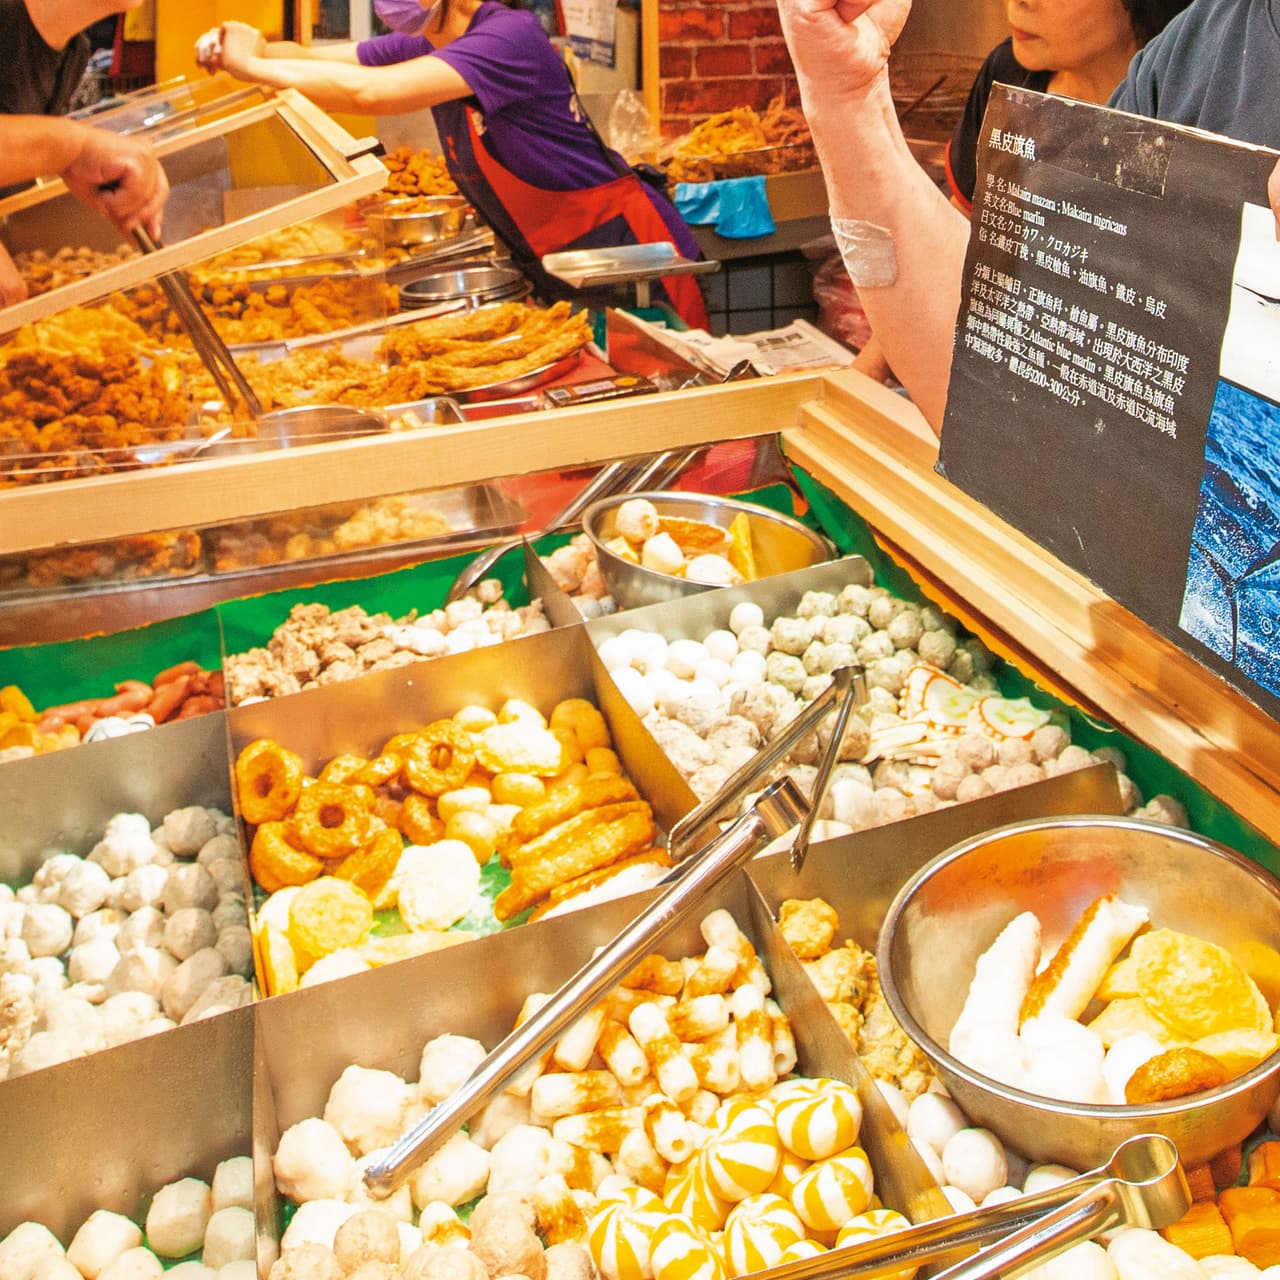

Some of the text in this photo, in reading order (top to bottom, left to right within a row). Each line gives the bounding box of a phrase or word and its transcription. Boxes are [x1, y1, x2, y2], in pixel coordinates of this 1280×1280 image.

[988, 127, 1036, 161] 黑皮旗魚
[1007, 181, 1031, 202] Makaira
[1031, 193, 1056, 212] mazara
[1061, 200, 1092, 225] Makaira
[1093, 212, 1128, 236] nigricans
[1022, 209, 1045, 227] marlin
